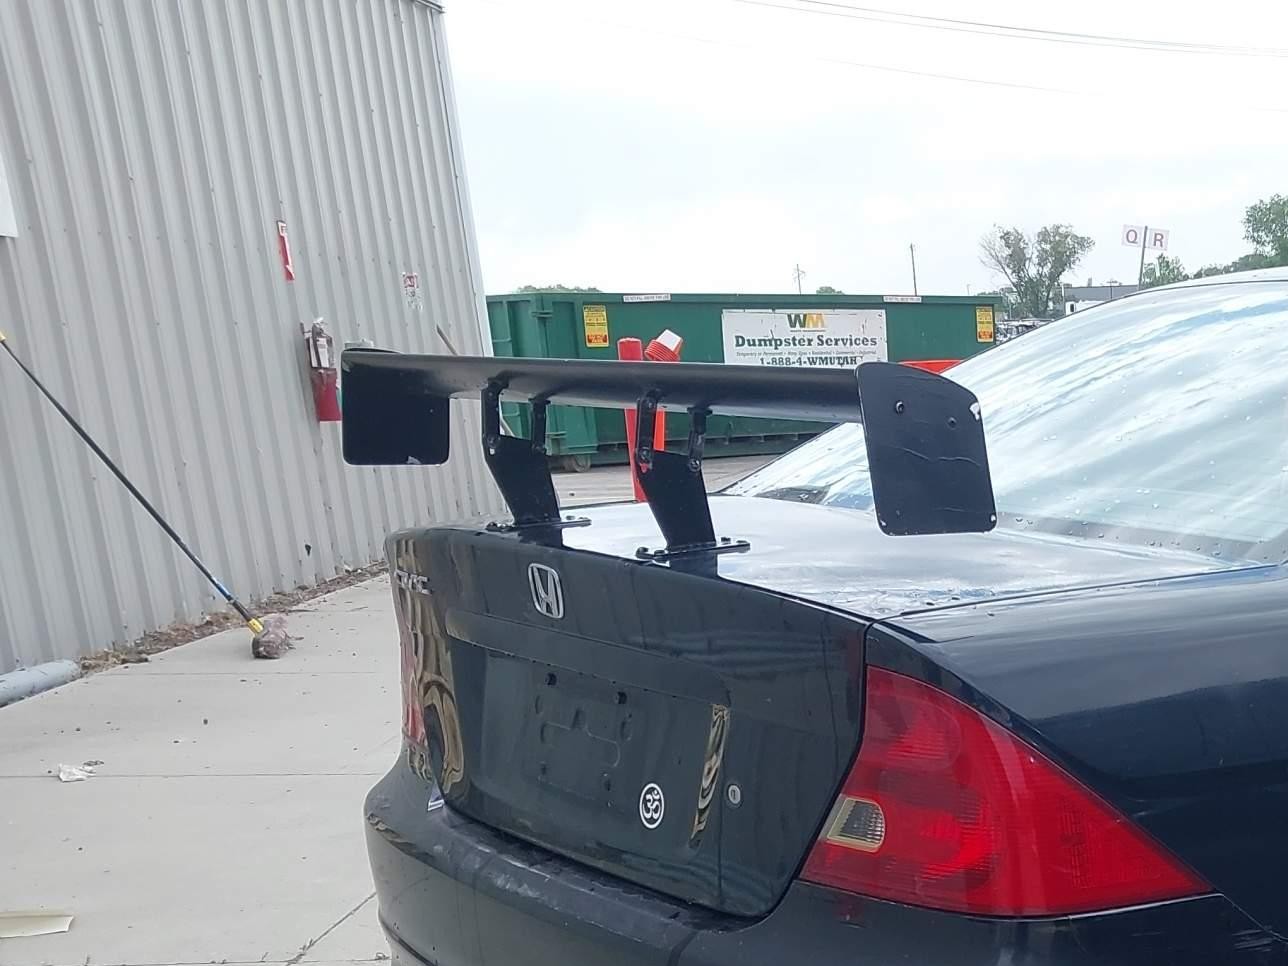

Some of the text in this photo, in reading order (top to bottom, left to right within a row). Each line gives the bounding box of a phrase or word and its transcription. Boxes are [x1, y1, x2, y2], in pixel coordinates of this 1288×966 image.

[1126, 229, 1138, 244] Q
[1153, 232, 1164, 247] R
[787, 313, 825, 329] WM
[734, 334, 878, 350] Dumpster Services
